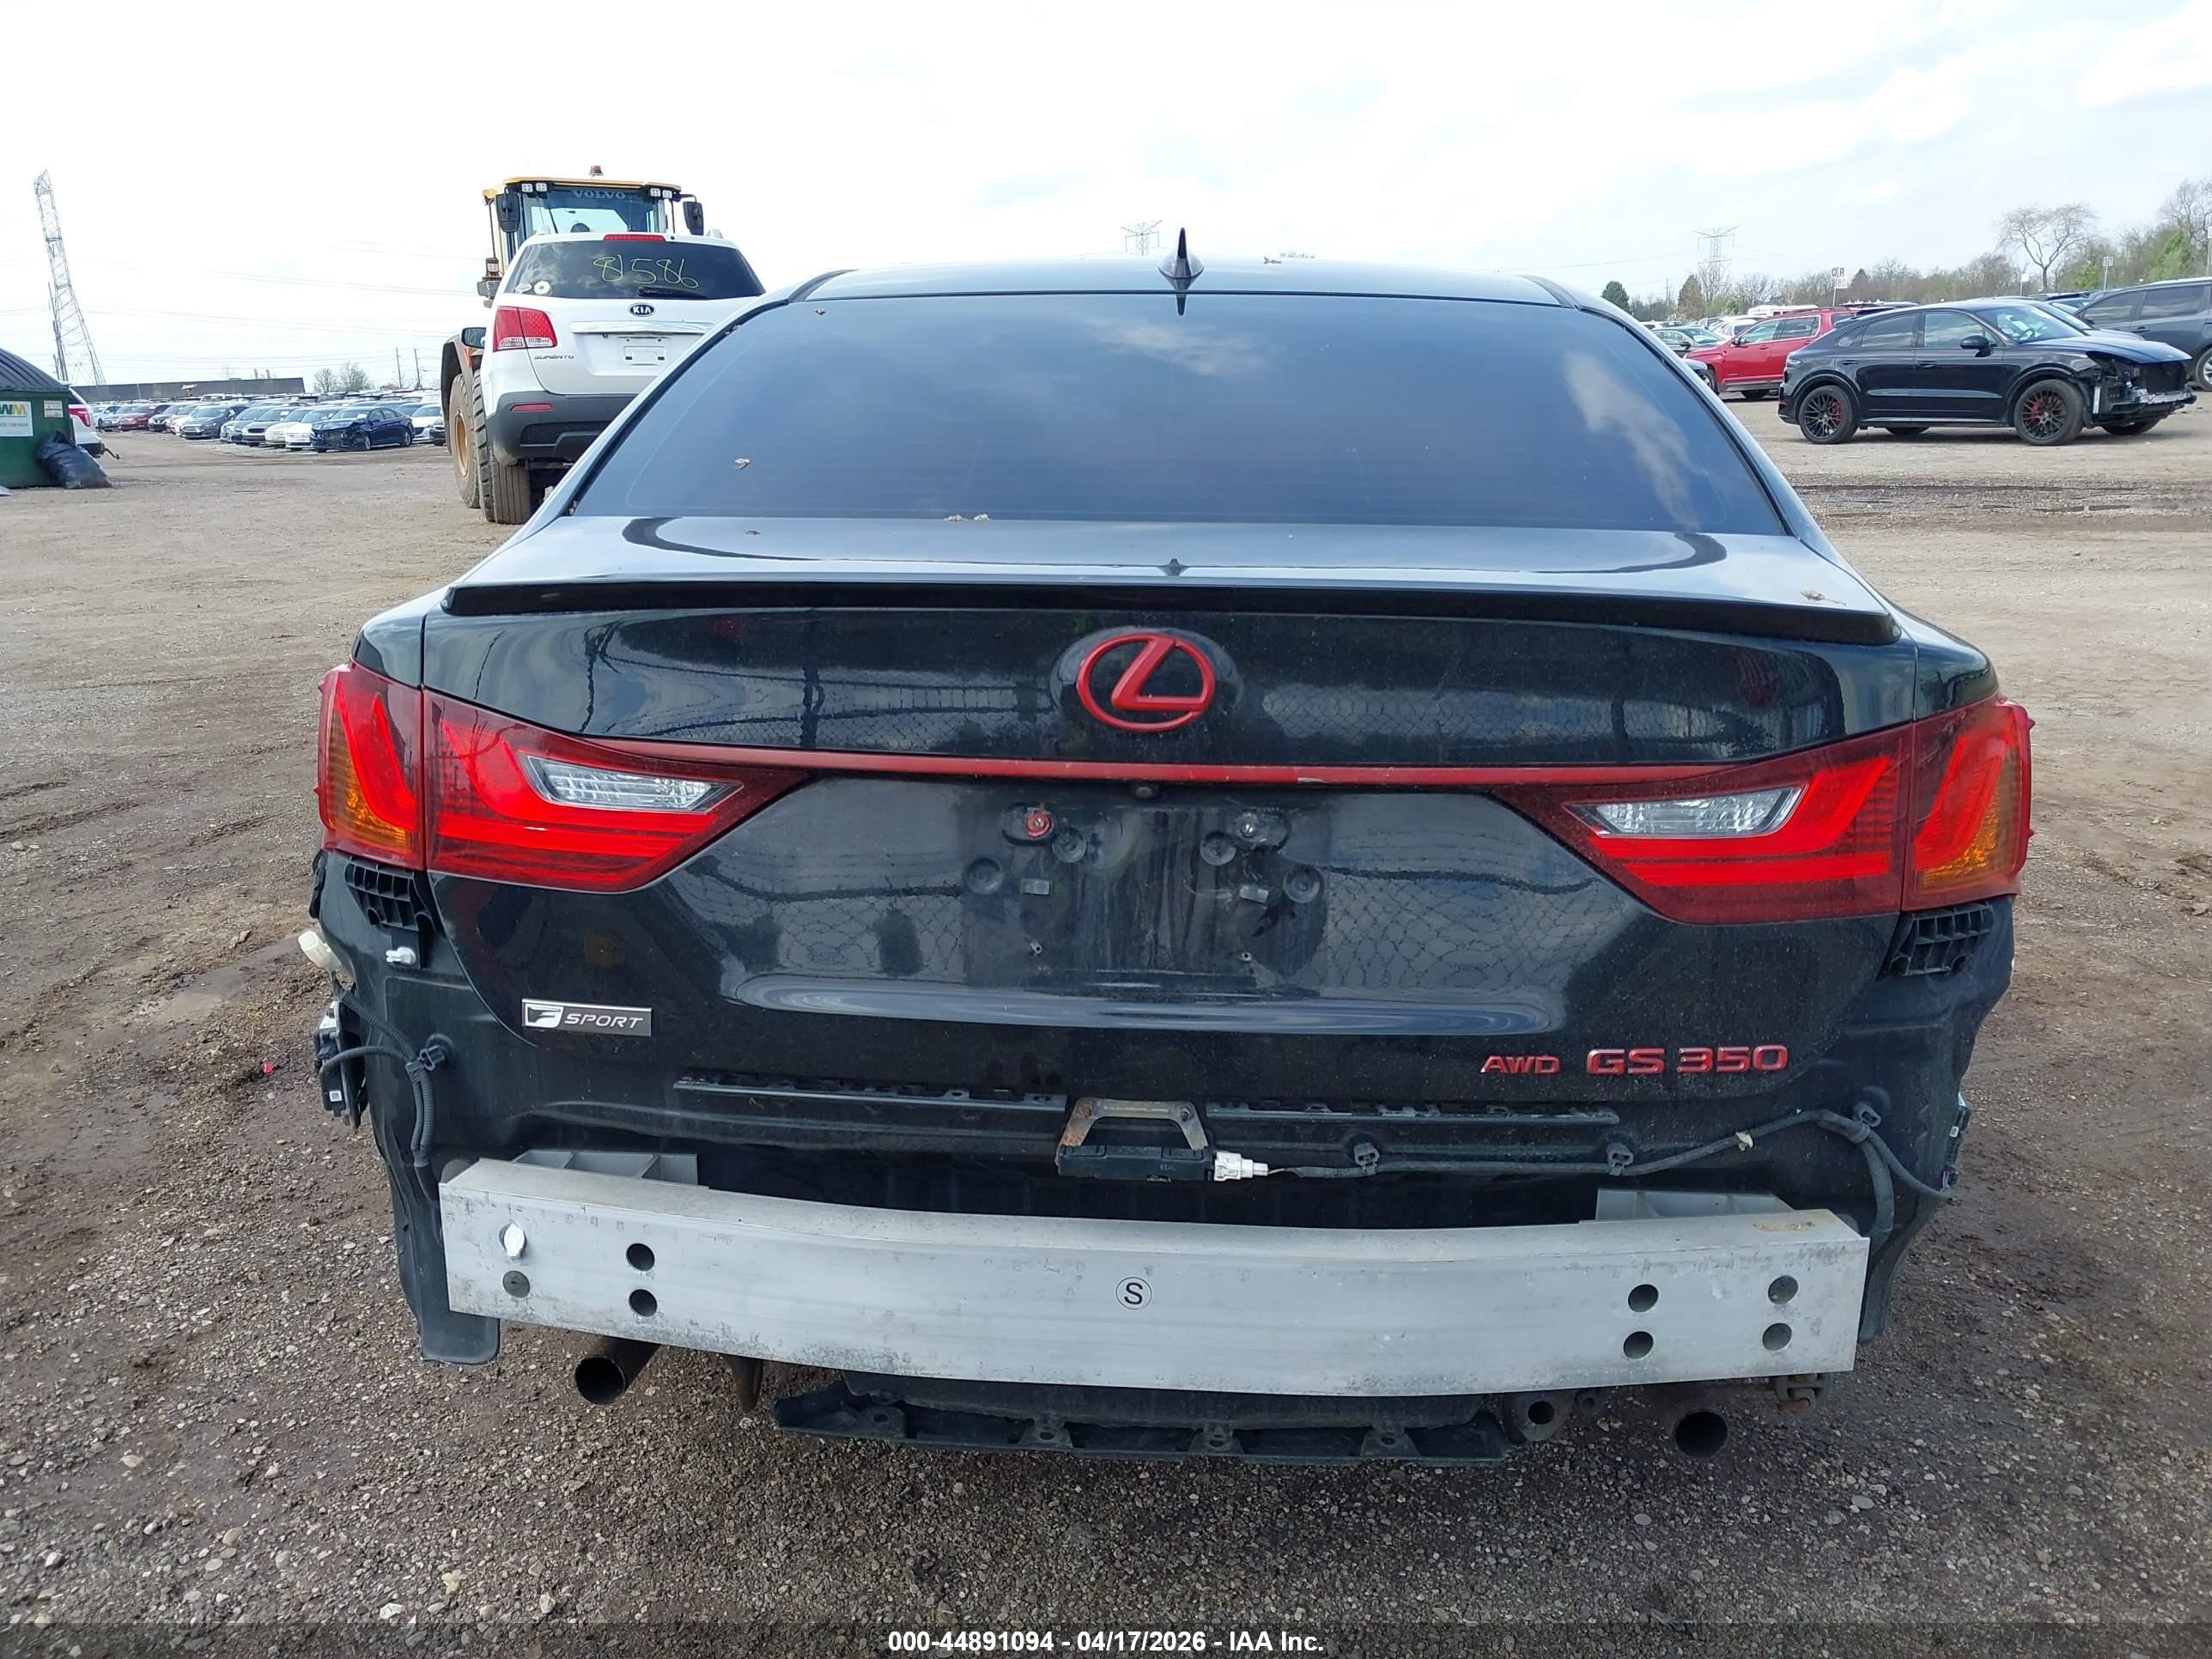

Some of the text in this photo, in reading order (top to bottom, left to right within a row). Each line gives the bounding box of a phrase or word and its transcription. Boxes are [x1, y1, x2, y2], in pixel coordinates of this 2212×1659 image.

[570, 190, 626, 199] VOLVO
[632, 305, 652, 315] KIA
[564, 1013, 644, 1029] SPORT
[1480, 1044, 1789, 1075] AWD GS 350
[1124, 1282, 1144, 1304] S
